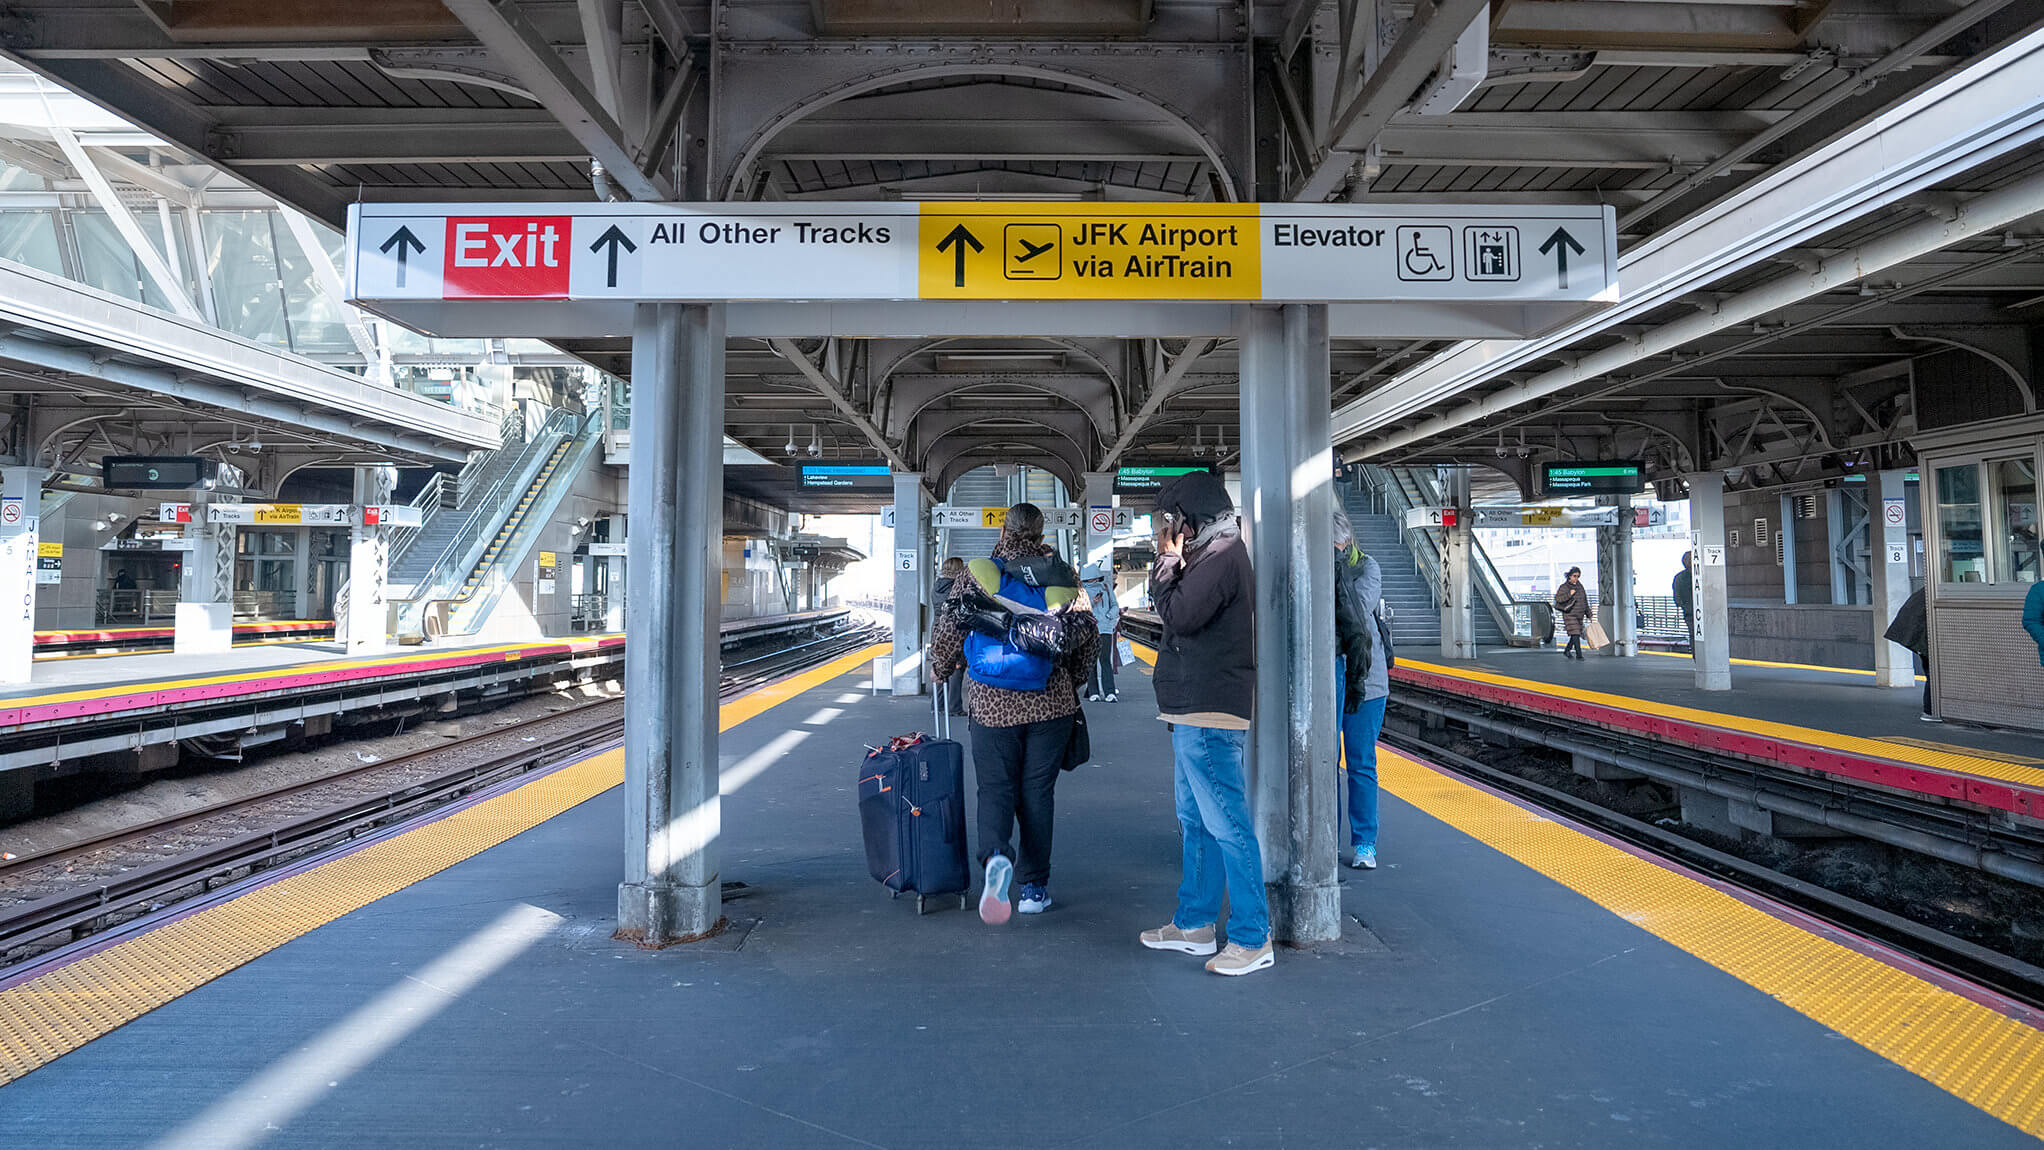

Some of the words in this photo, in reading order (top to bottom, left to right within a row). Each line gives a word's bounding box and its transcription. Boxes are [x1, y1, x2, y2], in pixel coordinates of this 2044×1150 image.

[650, 222, 685, 244] All
[699, 222, 782, 244] Other
[793, 222, 891, 244] Tracks
[1072, 223, 1129, 246] JFK
[1138, 223, 1238, 251] Airport
[1274, 223, 1386, 247] Elevator
[454, 222, 559, 268] Exit
[1072, 254, 1114, 278] via
[1123, 254, 1232, 278] AirTrain
[6, 546, 13, 555] 5
[1711, 555, 1718, 564] 7
[1893, 551, 1901, 561] 8
[23, 520, 35, 620] JAMAICA
[902, 559, 911, 569] 6
[1096, 559, 1103, 568] 7
[1693, 533, 1702, 636] JAMAICA
